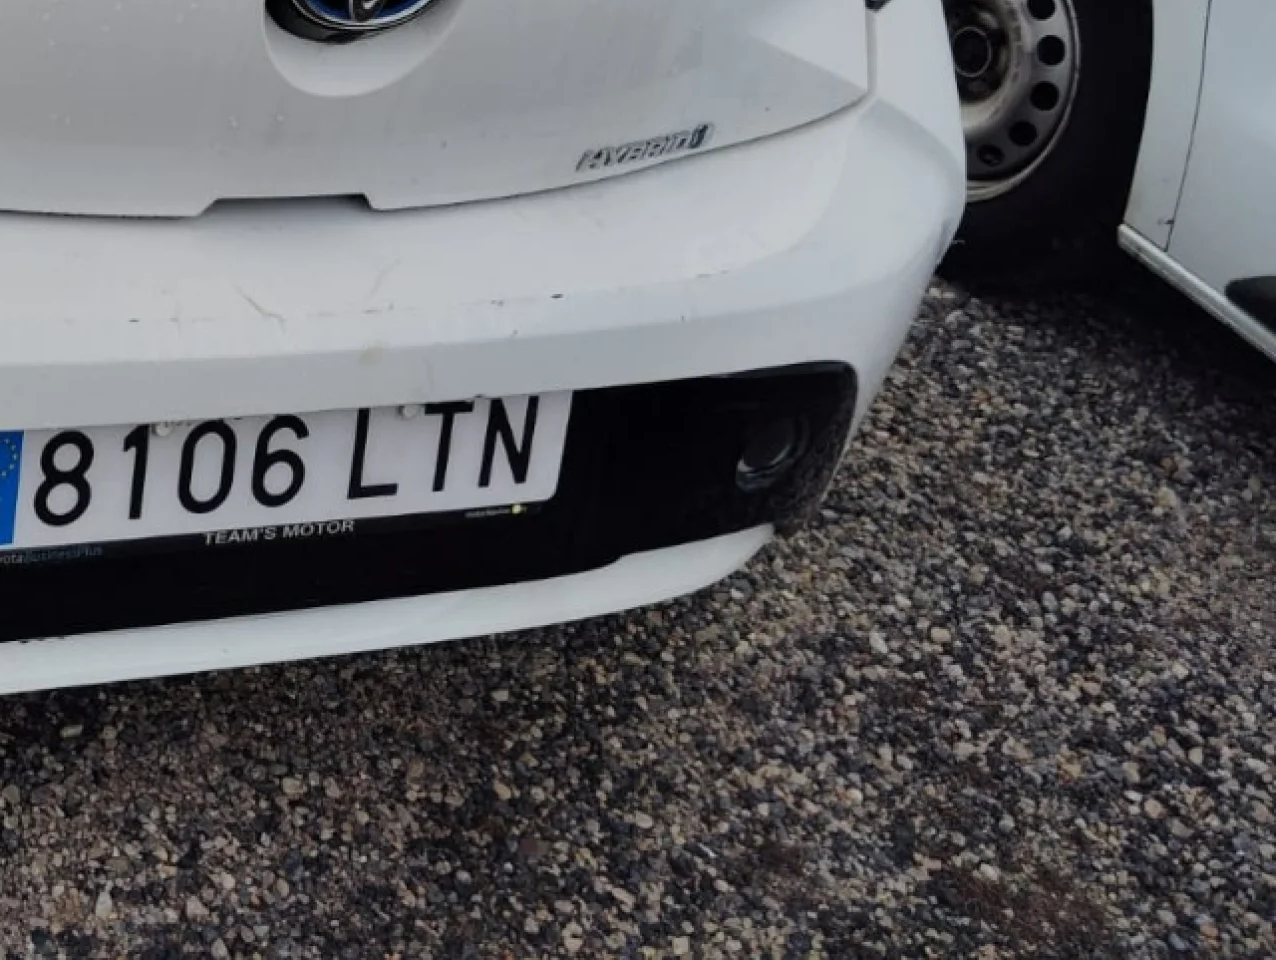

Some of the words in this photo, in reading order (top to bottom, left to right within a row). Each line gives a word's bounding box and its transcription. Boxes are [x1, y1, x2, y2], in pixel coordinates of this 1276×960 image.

[33, 413, 310, 528] 8106
[347, 395, 540, 500] LTN
[204, 526, 276, 546] TEAM'S
[282, 519, 355, 539] MOTOR
